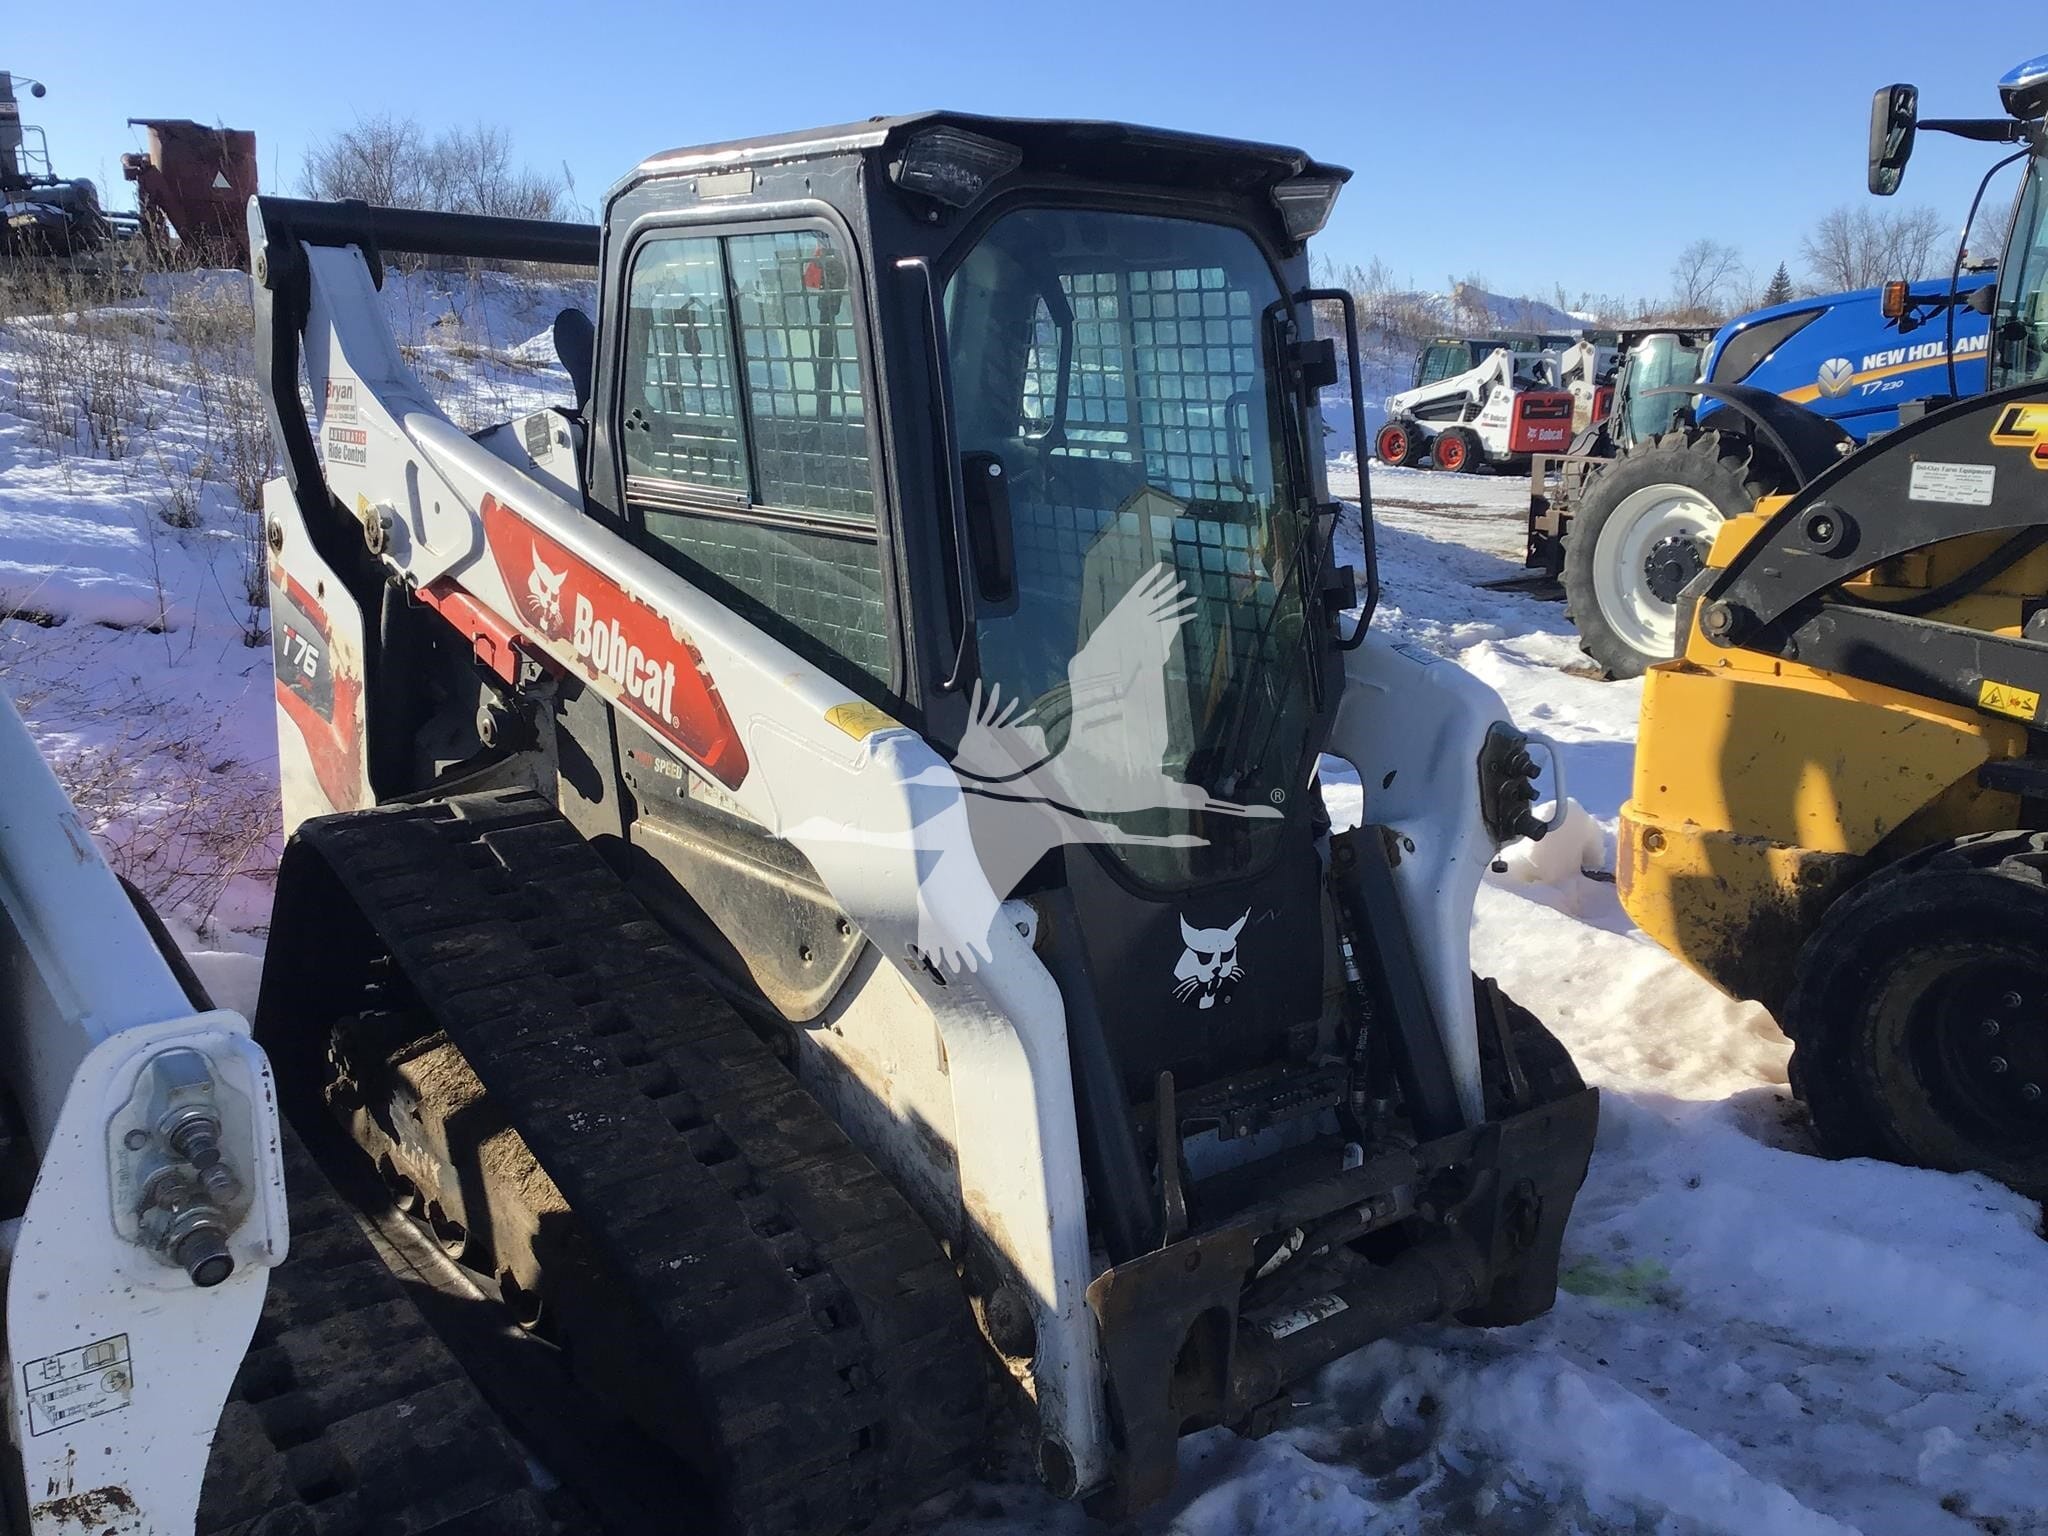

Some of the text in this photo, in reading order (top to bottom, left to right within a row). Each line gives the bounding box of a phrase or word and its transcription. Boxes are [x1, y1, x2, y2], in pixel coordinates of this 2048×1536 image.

[1862, 334, 1988, 371] NEW HOLAN
[326, 380, 353, 402] Bryan
[1861, 379, 1904, 396] T7 230
[329, 428, 367, 444] AUTOMATIC
[1538, 428, 1563, 440] Bobcat
[328, 443, 367, 463] Ride Control
[283, 623, 320, 679] T76
[574, 592, 676, 725] Bobcat
[654, 757, 683, 780] SPEED
